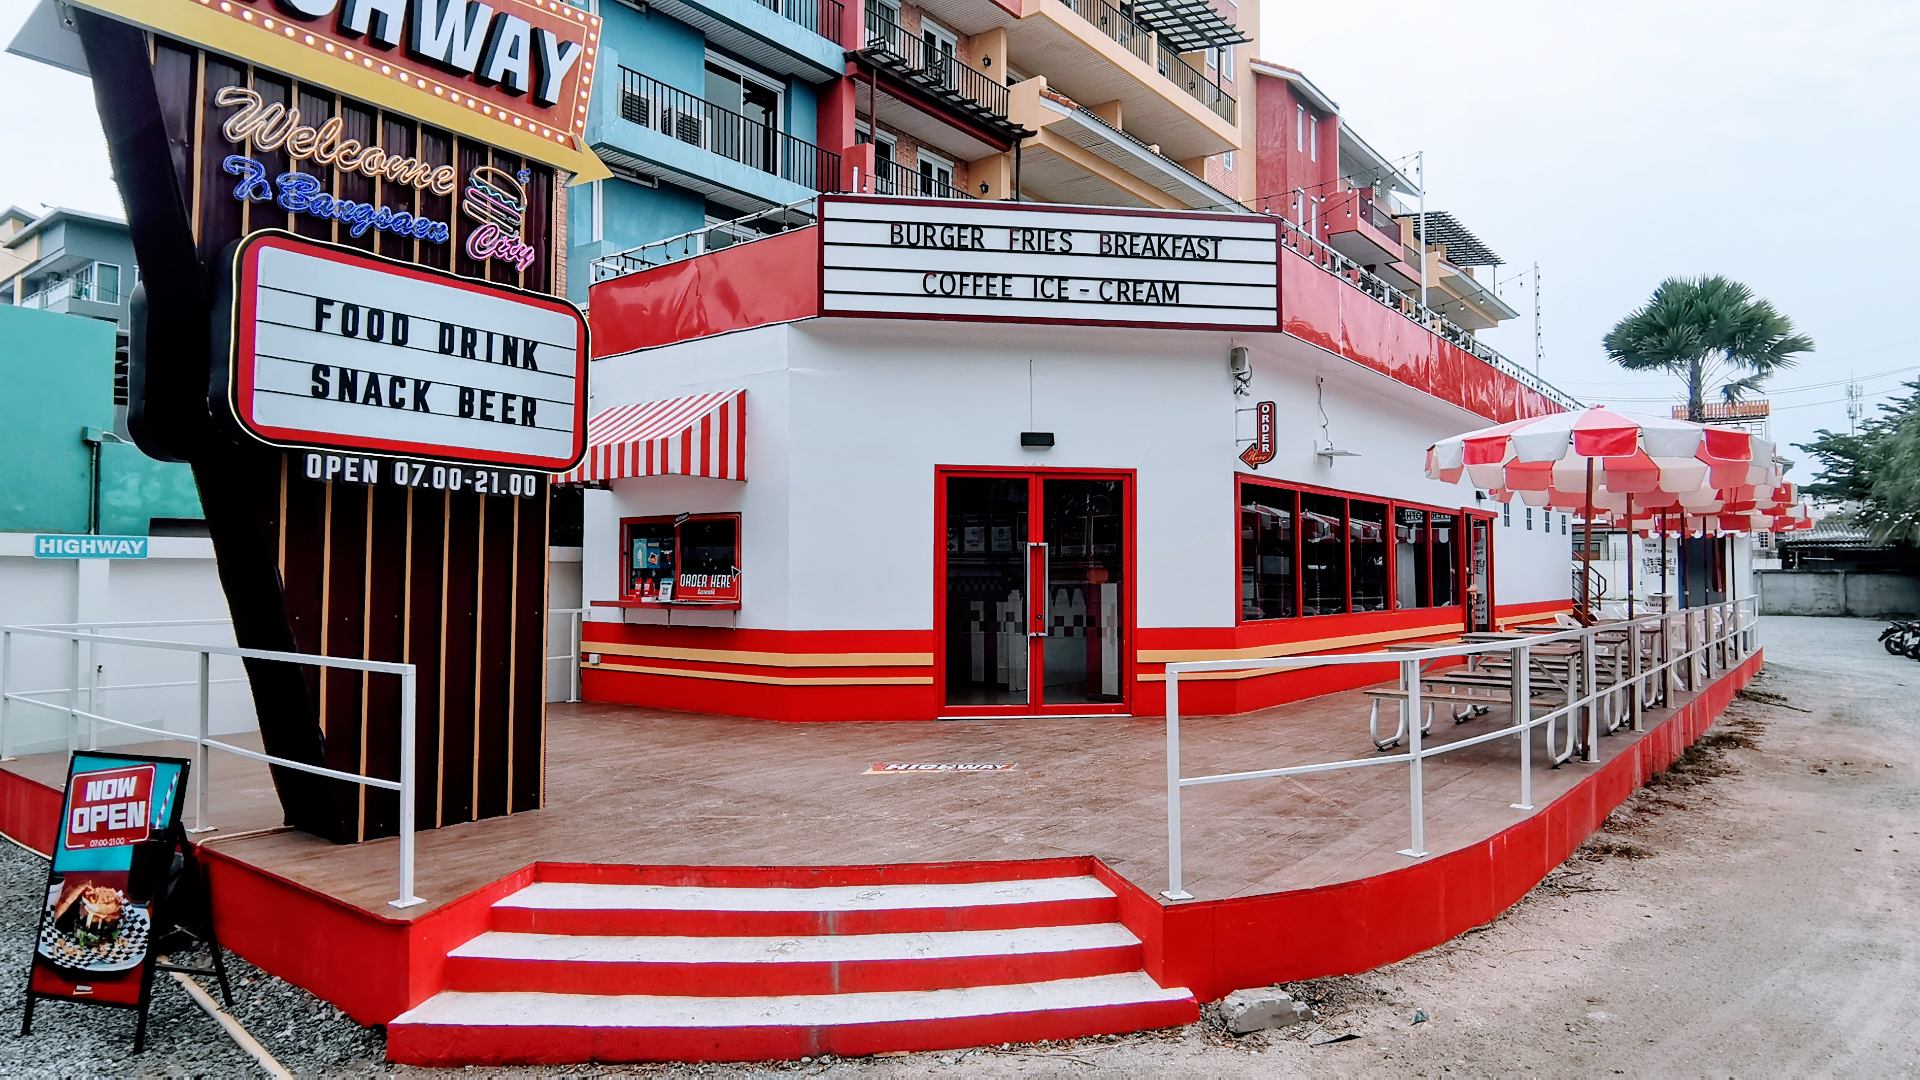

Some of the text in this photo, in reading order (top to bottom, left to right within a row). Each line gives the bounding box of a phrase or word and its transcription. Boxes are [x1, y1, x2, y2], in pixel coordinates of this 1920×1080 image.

[290, 0, 582, 105] HWAY
[215, 86, 456, 196] Welcome
[222, 155, 450, 244] To Bangsaen
[465, 222, 535, 272] City
[890, 223, 1223, 260] BURGER FRIES BREAKFAST
[922, 272, 1014, 298] COFFEE
[1033, 276, 1070, 300] ICE
[1099, 279, 1181, 304] CREAM
[315, 297, 539, 371] FOOD DRINK
[311, 363, 537, 427] SNACK BEER
[1261, 404, 1271, 453] ORDER
[306, 453, 536, 497] OPEN 07.00-21.00
[39, 538, 145, 555] HIGHWAY
[680, 573, 732, 588] ORDER HERE
[86, 776, 137, 802] NOW
[884, 763, 1009, 771] HIGHWAY
[71, 801, 146, 834] OPEN
